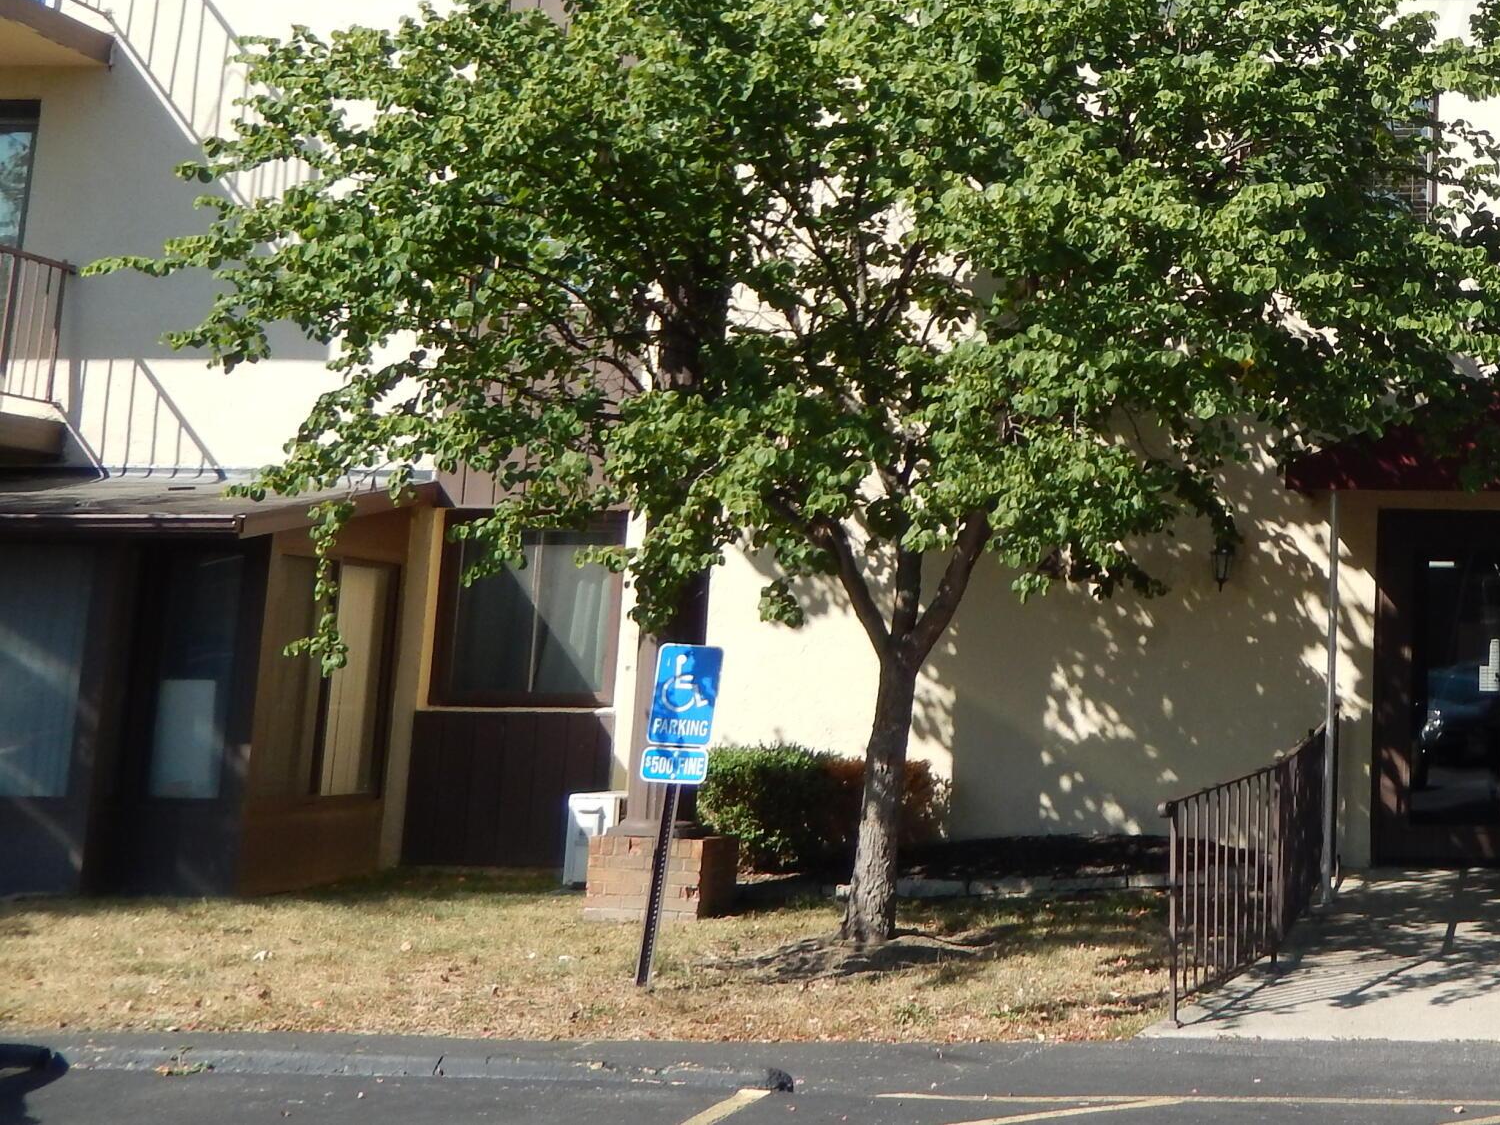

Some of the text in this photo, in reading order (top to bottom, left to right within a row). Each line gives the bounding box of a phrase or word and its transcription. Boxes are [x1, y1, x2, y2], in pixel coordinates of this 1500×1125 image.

[653, 718, 708, 737] PARKING
[645, 755, 705, 775] $500 FINE
